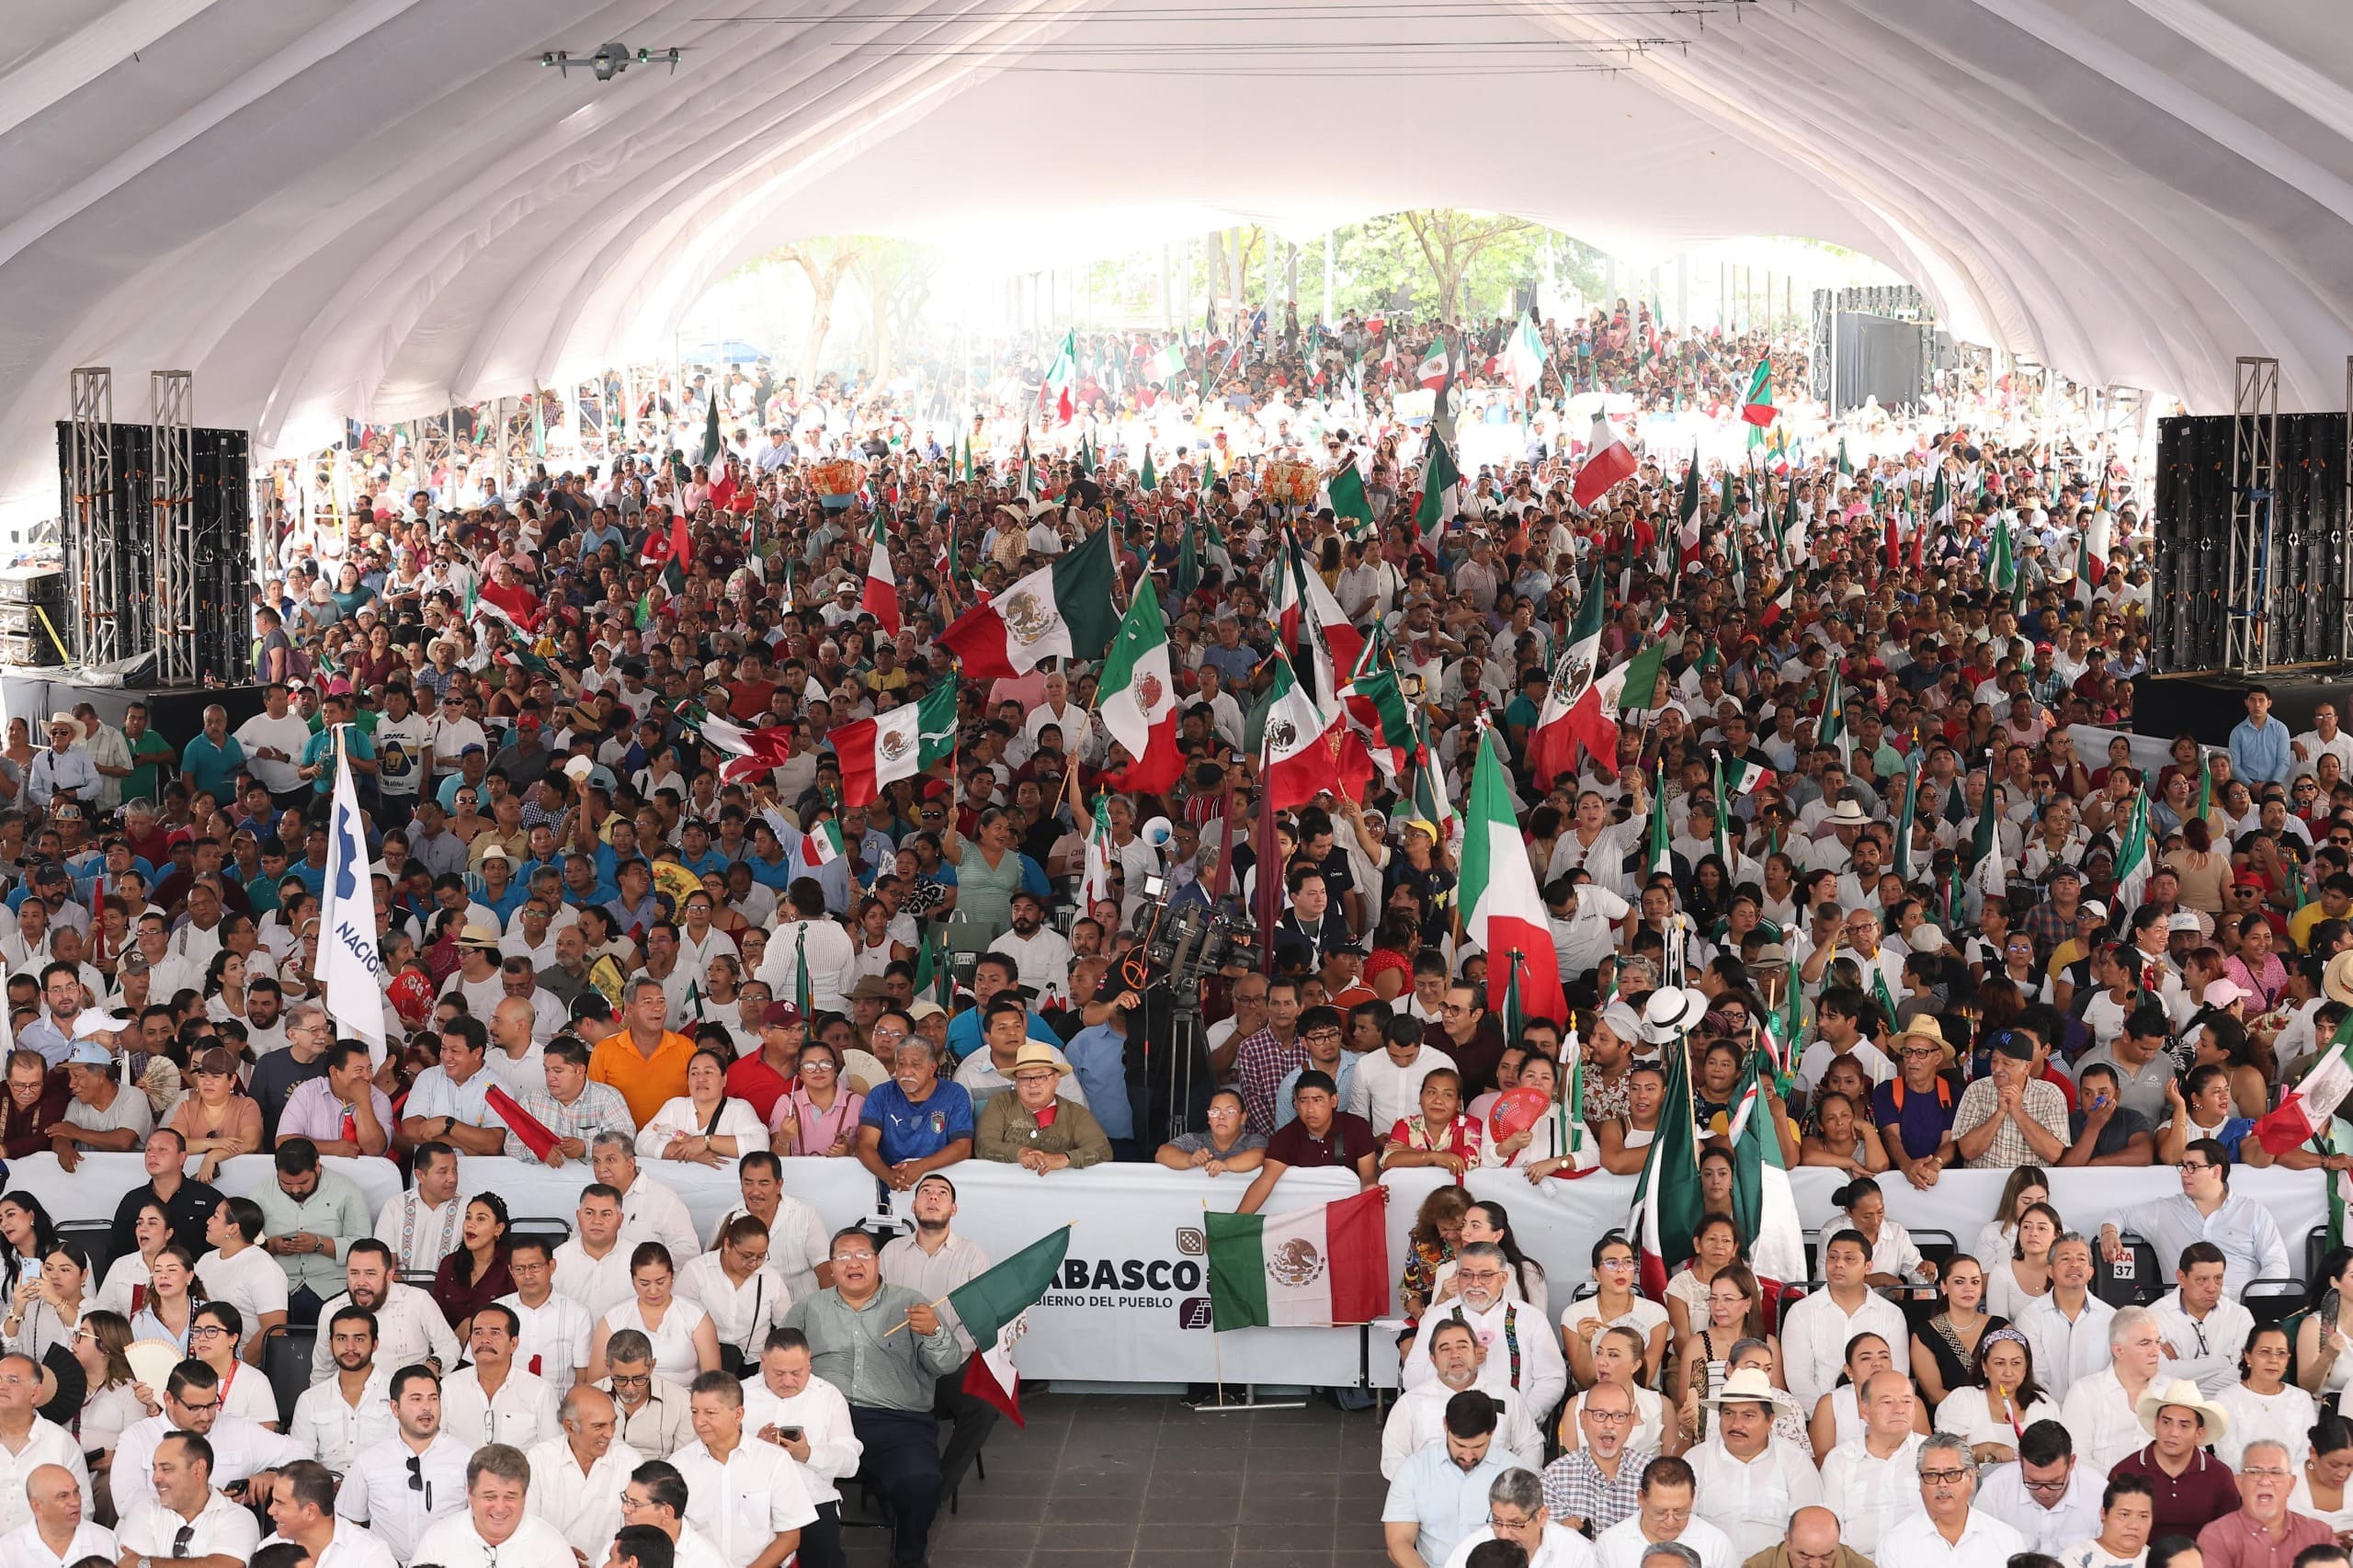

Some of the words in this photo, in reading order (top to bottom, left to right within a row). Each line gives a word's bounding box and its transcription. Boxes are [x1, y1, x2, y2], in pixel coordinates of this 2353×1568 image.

[2115, 1265, 2132, 1277] 37
[1089, 1296, 1115, 1307] DEL
[1119, 1297, 1173, 1308] PUEBLO
